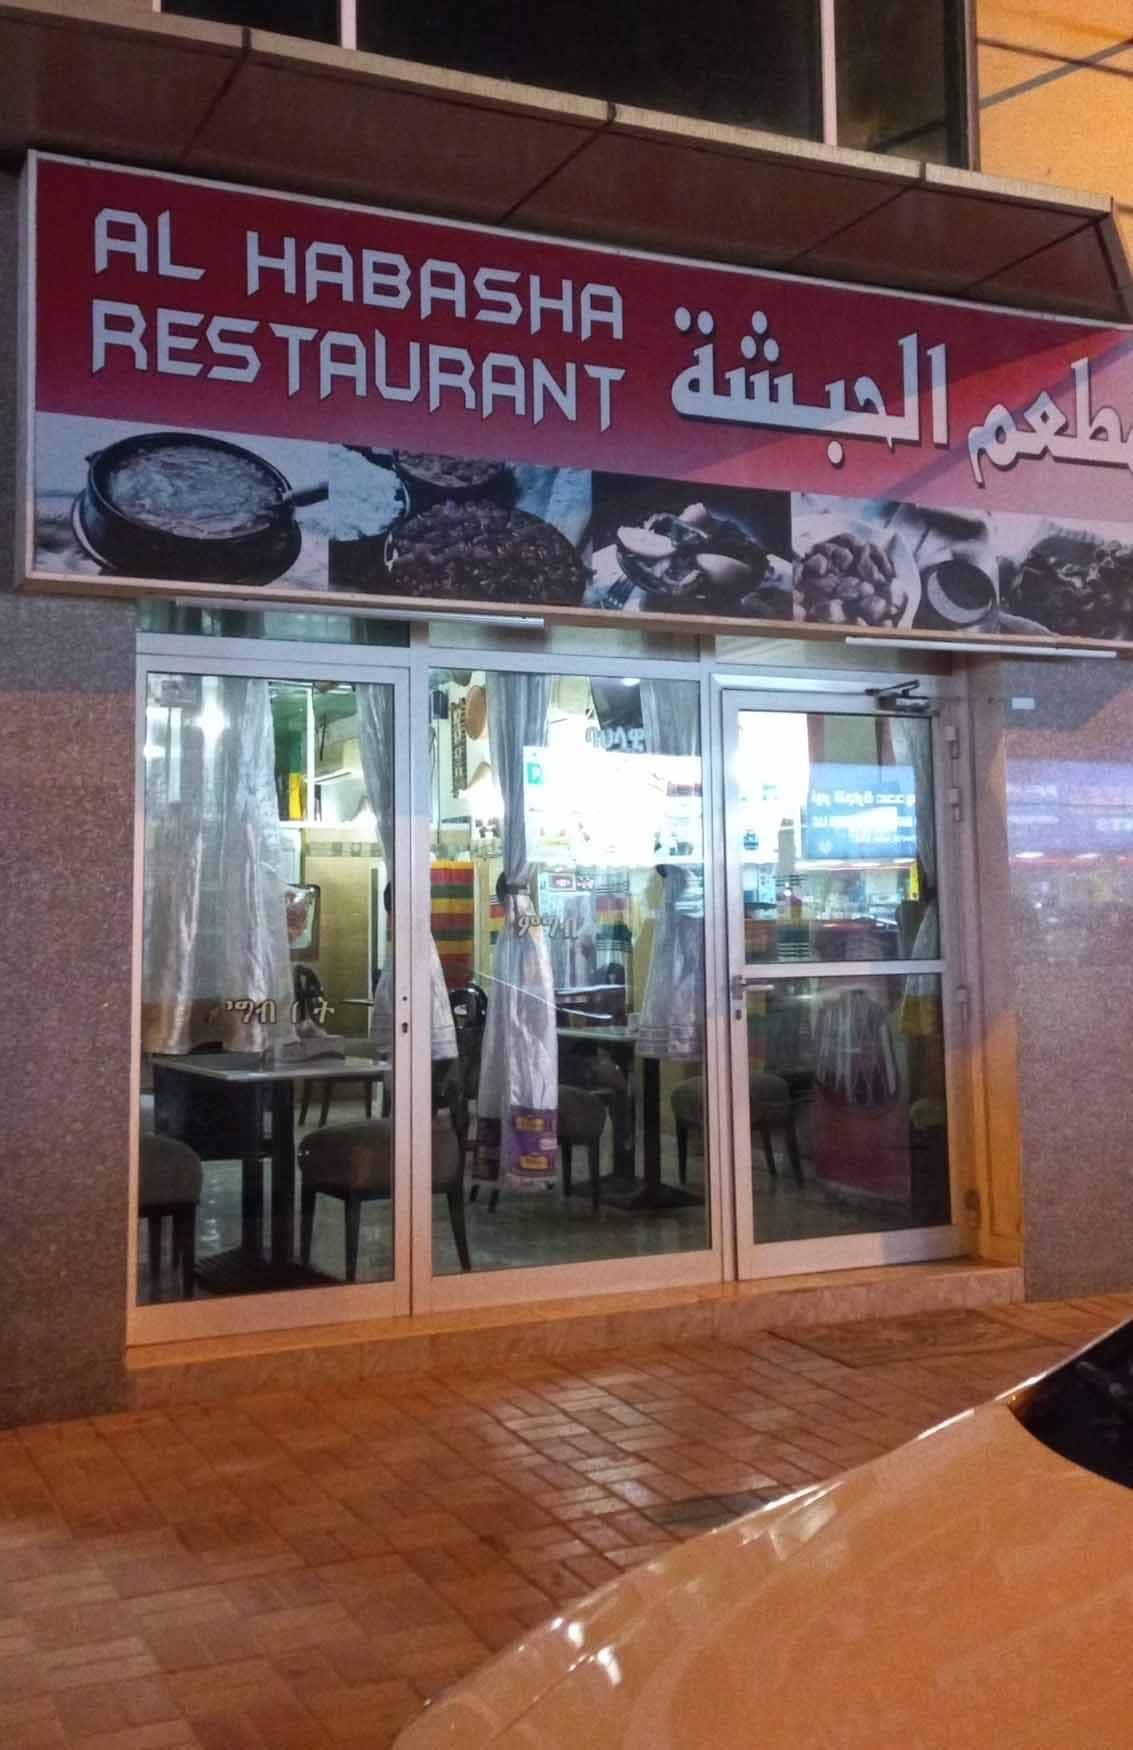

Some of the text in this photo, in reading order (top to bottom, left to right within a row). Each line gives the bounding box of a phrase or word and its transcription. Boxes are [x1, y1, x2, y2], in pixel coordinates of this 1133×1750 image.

[93, 208, 624, 341] AL HABASHA
[91, 298, 626, 432] RESTAURANT
[671, 306, 1133, 488] طعم الحبشة
